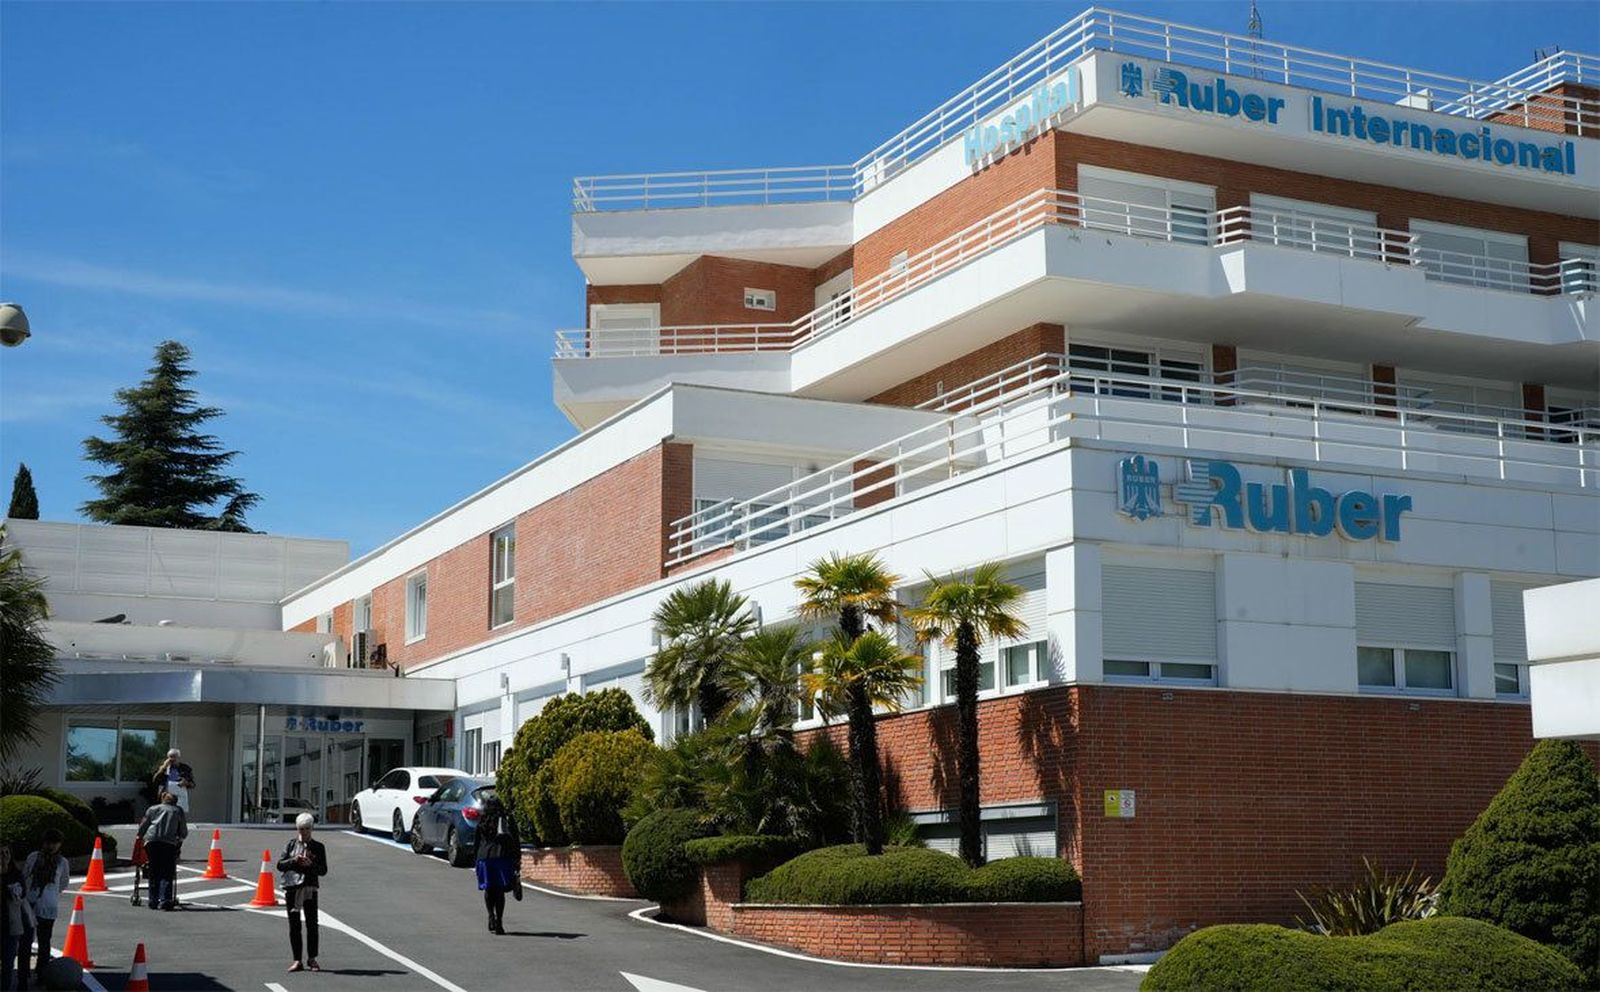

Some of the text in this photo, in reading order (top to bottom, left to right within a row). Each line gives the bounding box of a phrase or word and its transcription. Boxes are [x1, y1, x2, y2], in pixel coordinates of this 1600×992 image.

[964, 64, 1078, 166] Hospital
[1152, 67, 1576, 174] Ruber Internacional
[1176, 459, 1412, 542] Ruber
[304, 717, 365, 732] Ruber
